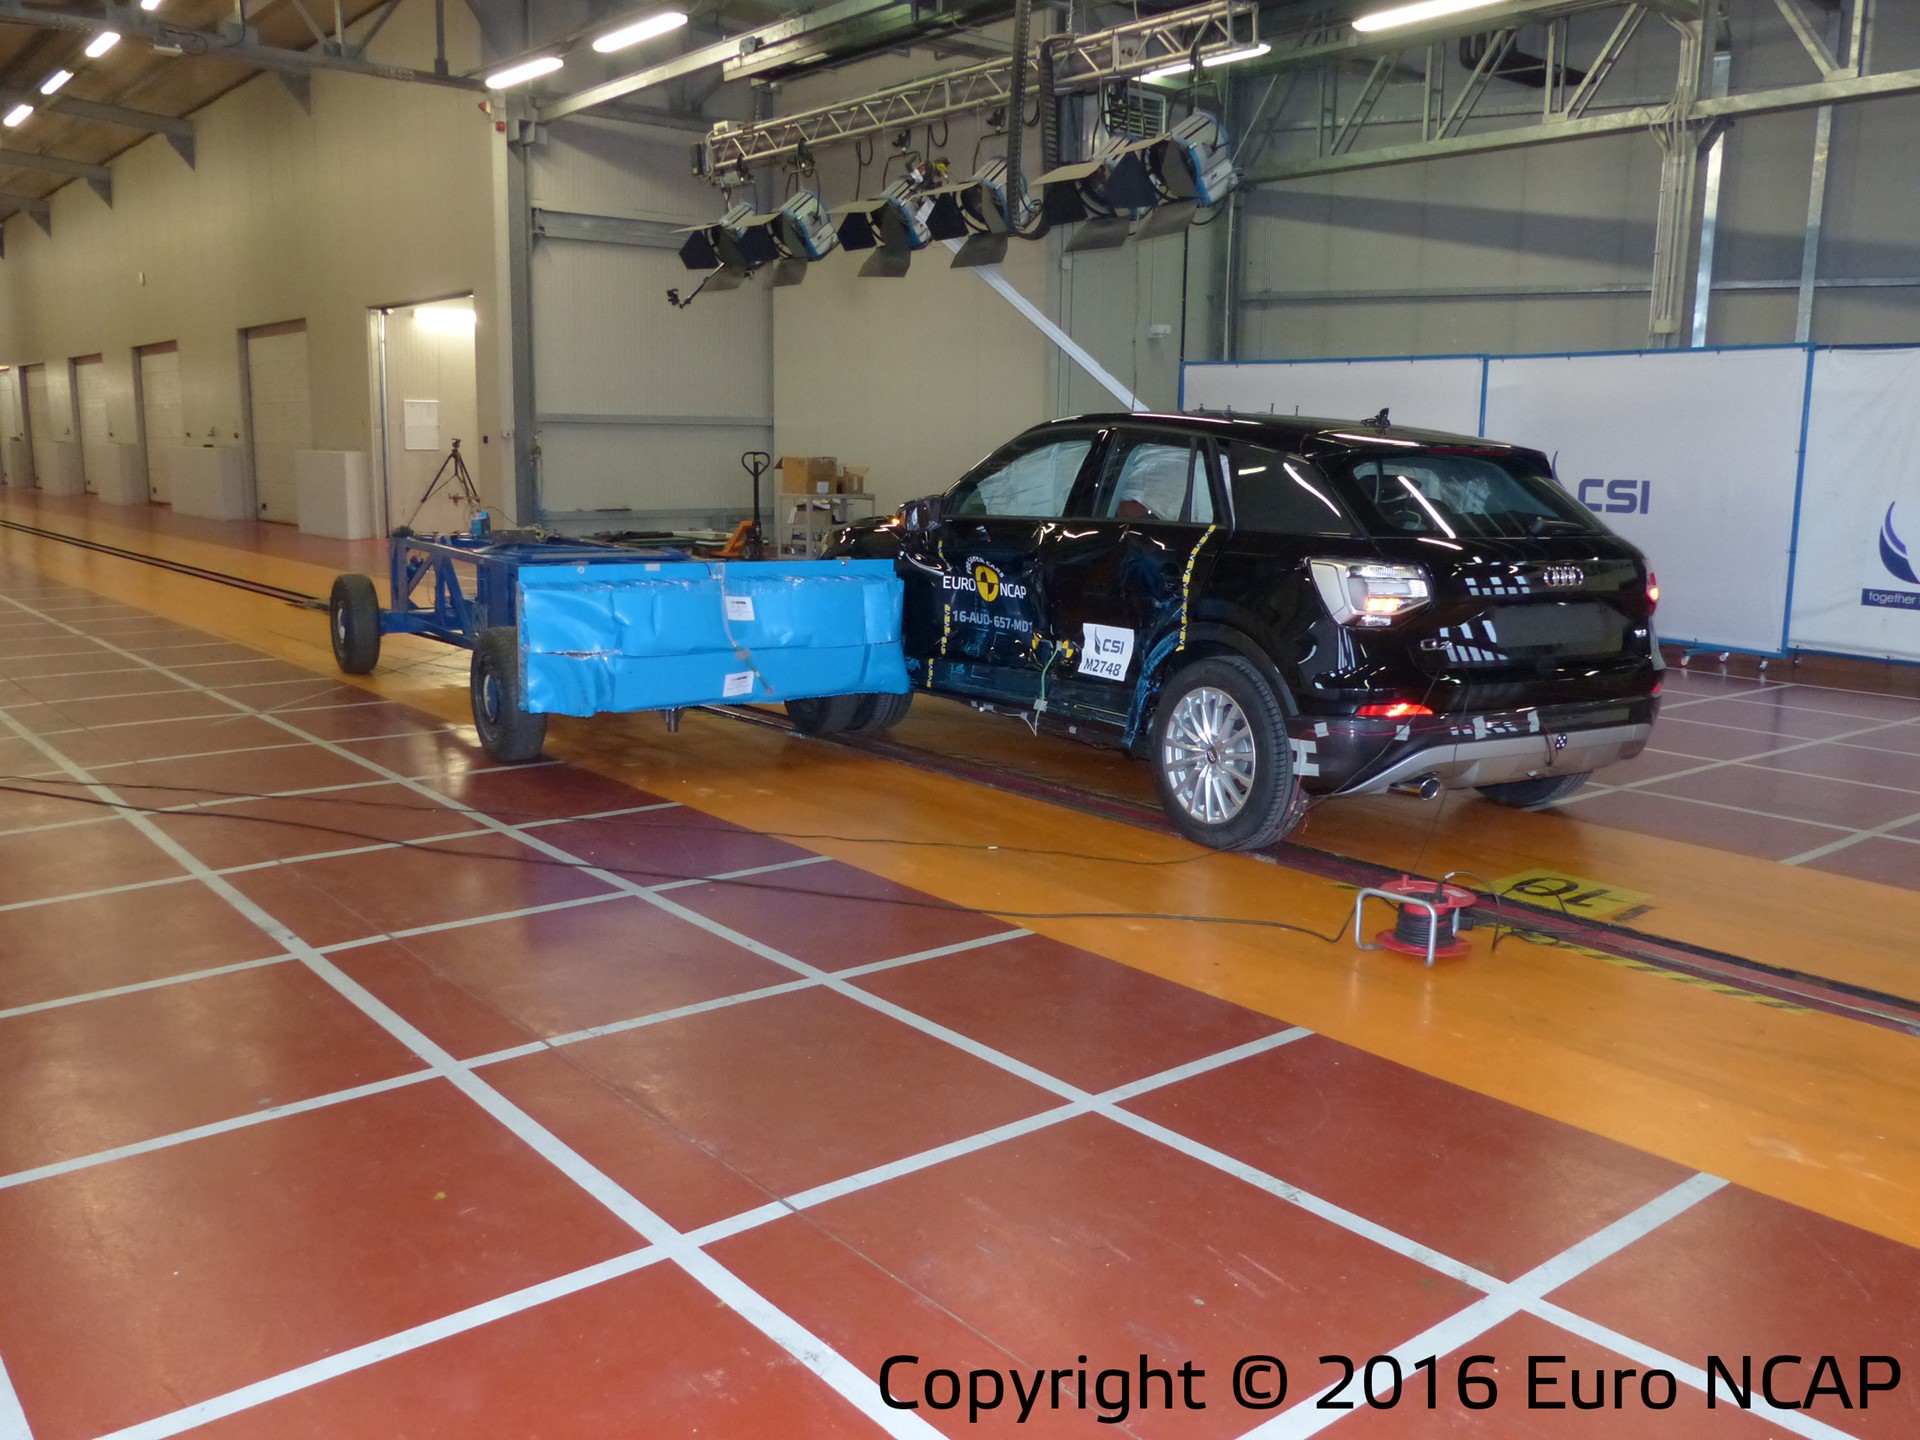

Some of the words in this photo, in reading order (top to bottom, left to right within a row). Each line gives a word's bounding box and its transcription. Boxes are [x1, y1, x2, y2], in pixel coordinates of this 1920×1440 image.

[1578, 479, 1650, 514] CSI
[943, 576, 976, 591] EURO
[1000, 583, 1026, 599] NCAP
[1868, 591, 1916, 605] together
[1102, 639, 1124, 654] CSI
[1083, 658, 1121, 676] M2748
